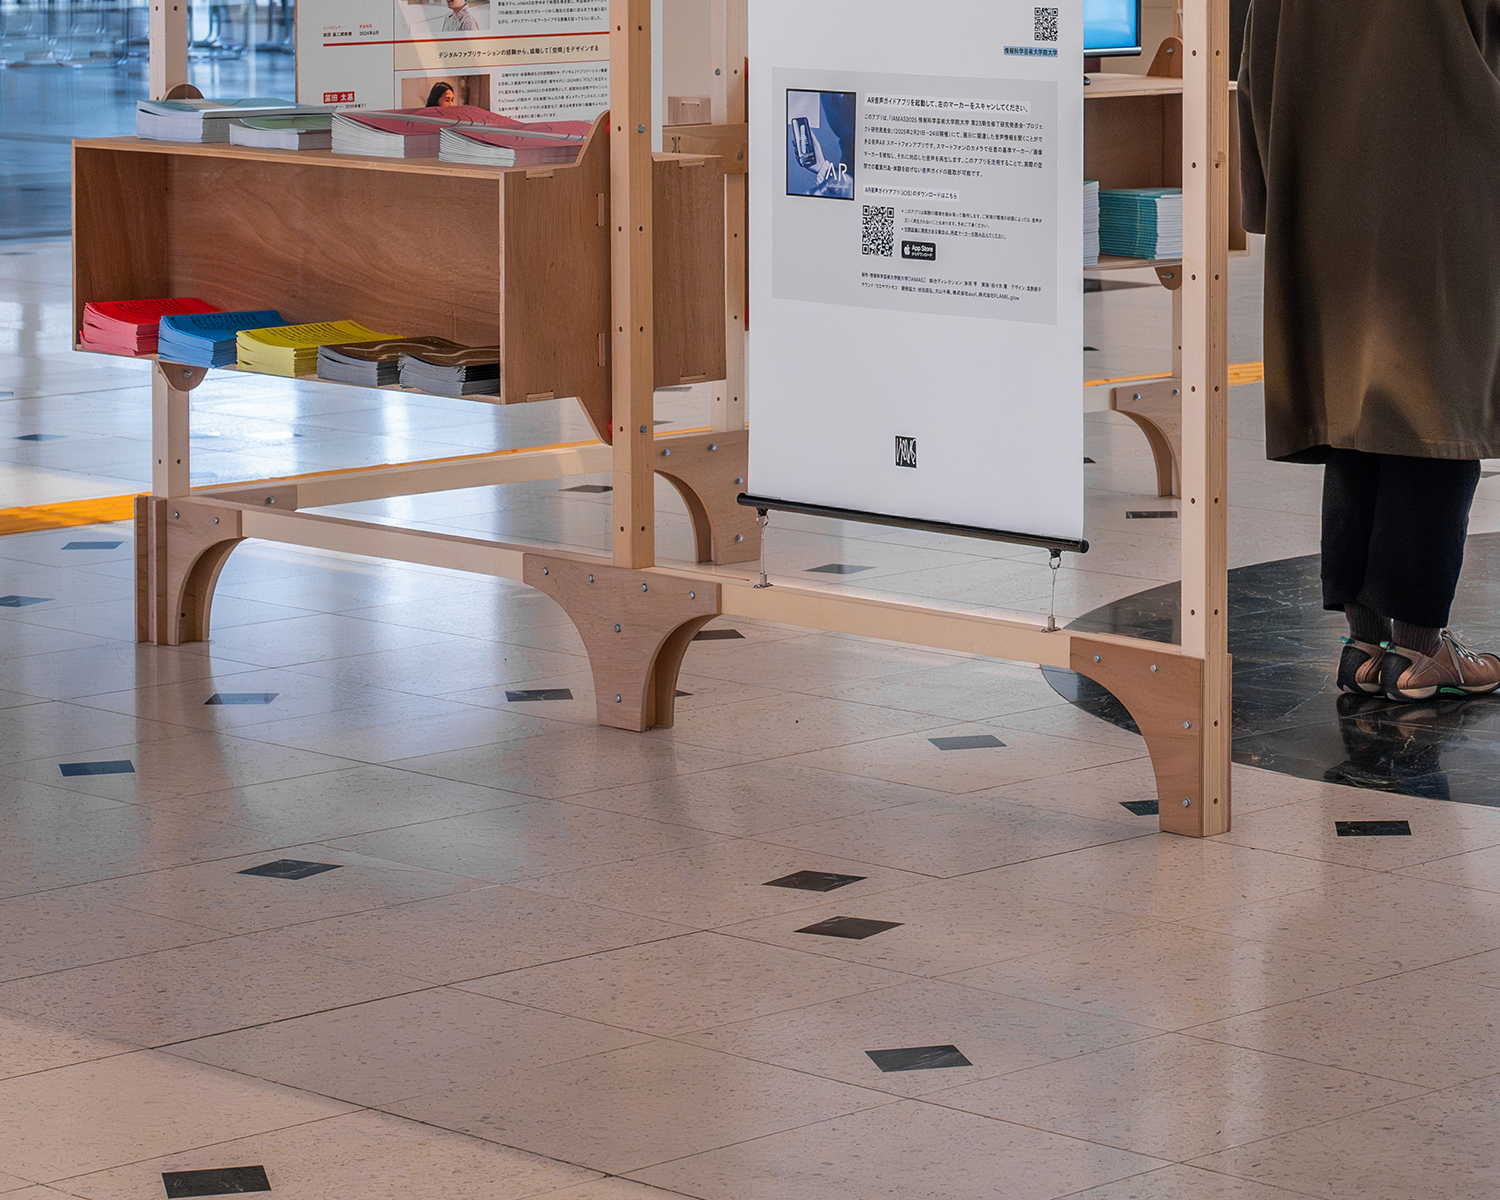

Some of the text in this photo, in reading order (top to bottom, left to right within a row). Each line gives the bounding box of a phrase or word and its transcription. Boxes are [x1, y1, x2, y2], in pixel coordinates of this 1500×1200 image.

[1004, 48, 1058, 56] 情報科学芸術大学院大学
[826, 163, 847, 181] AR
